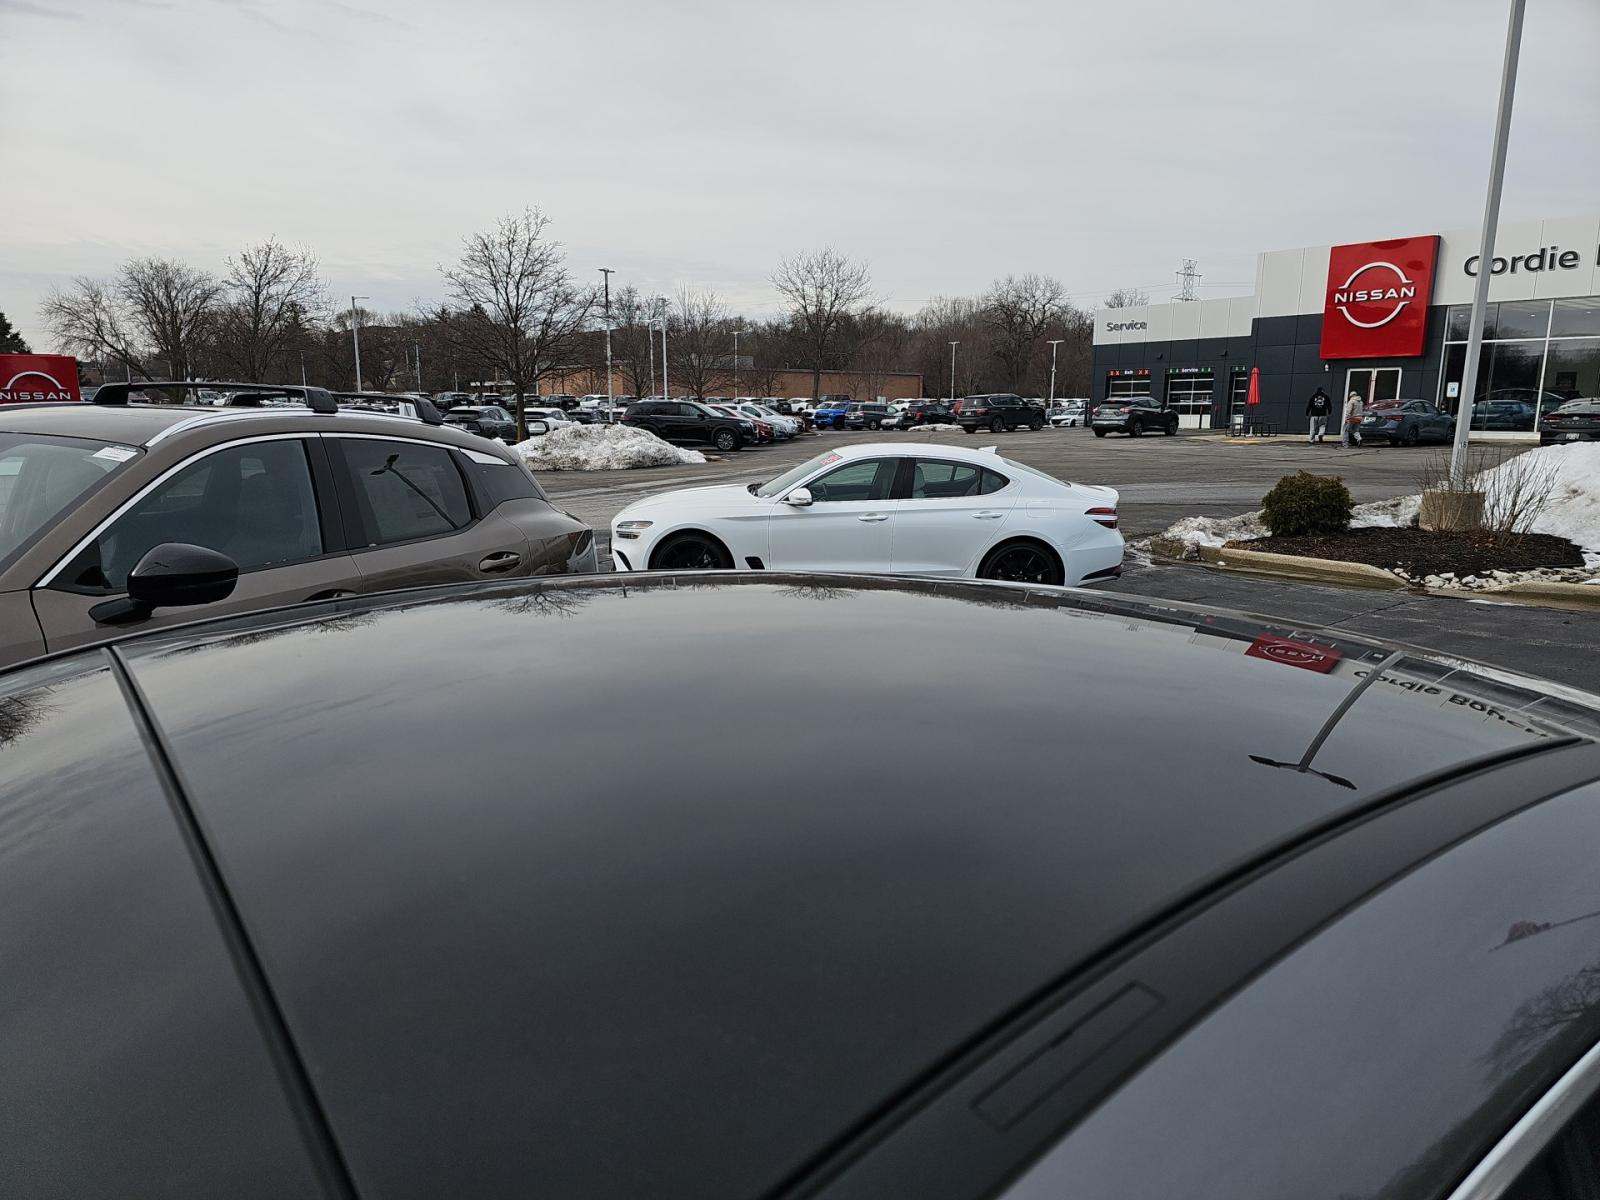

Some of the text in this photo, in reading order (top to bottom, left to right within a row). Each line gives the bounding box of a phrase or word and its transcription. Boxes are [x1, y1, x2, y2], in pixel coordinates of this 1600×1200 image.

[1334, 286, 1415, 304] NISSAN
[1106, 320, 1148, 332] Service
[0, 391, 71, 400] NISSAN
